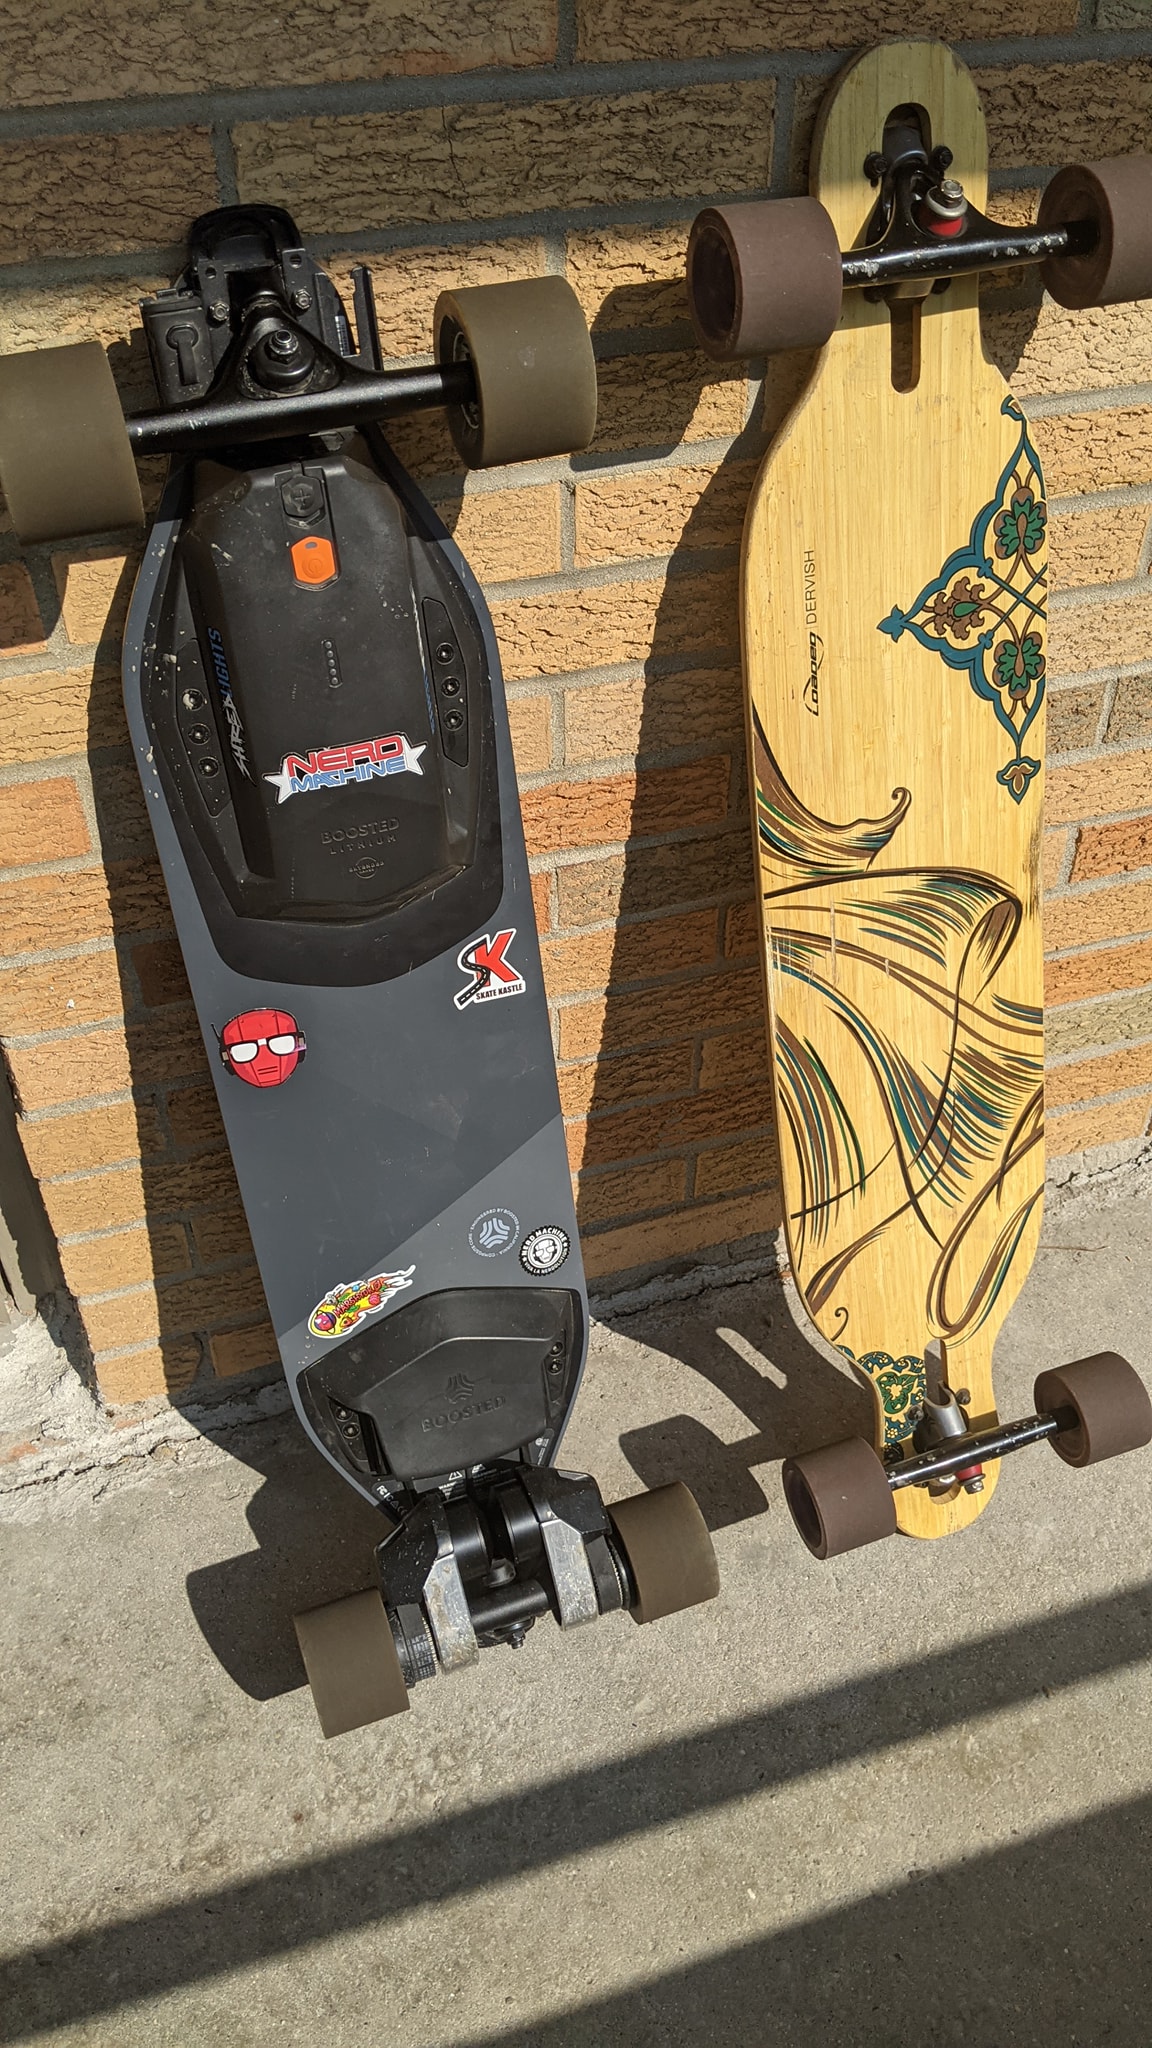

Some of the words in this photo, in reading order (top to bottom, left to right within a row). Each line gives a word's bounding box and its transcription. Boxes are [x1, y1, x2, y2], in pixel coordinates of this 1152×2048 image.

[803, 550, 818, 625] DERVISH
[286, 735, 404, 778] NERD
[290, 755, 407, 792] MACHINE
[321, 816, 400, 844] BOOSTED
[329, 835, 397, 855] LITHIUM
[475, 988, 497, 1000] SKATE
[498, 983, 523, 996] KASTLE
[521, 1235, 535, 1256] NERD
[535, 1227, 568, 1242] MACHINE
[422, 1394, 506, 1433] BOOSTED
